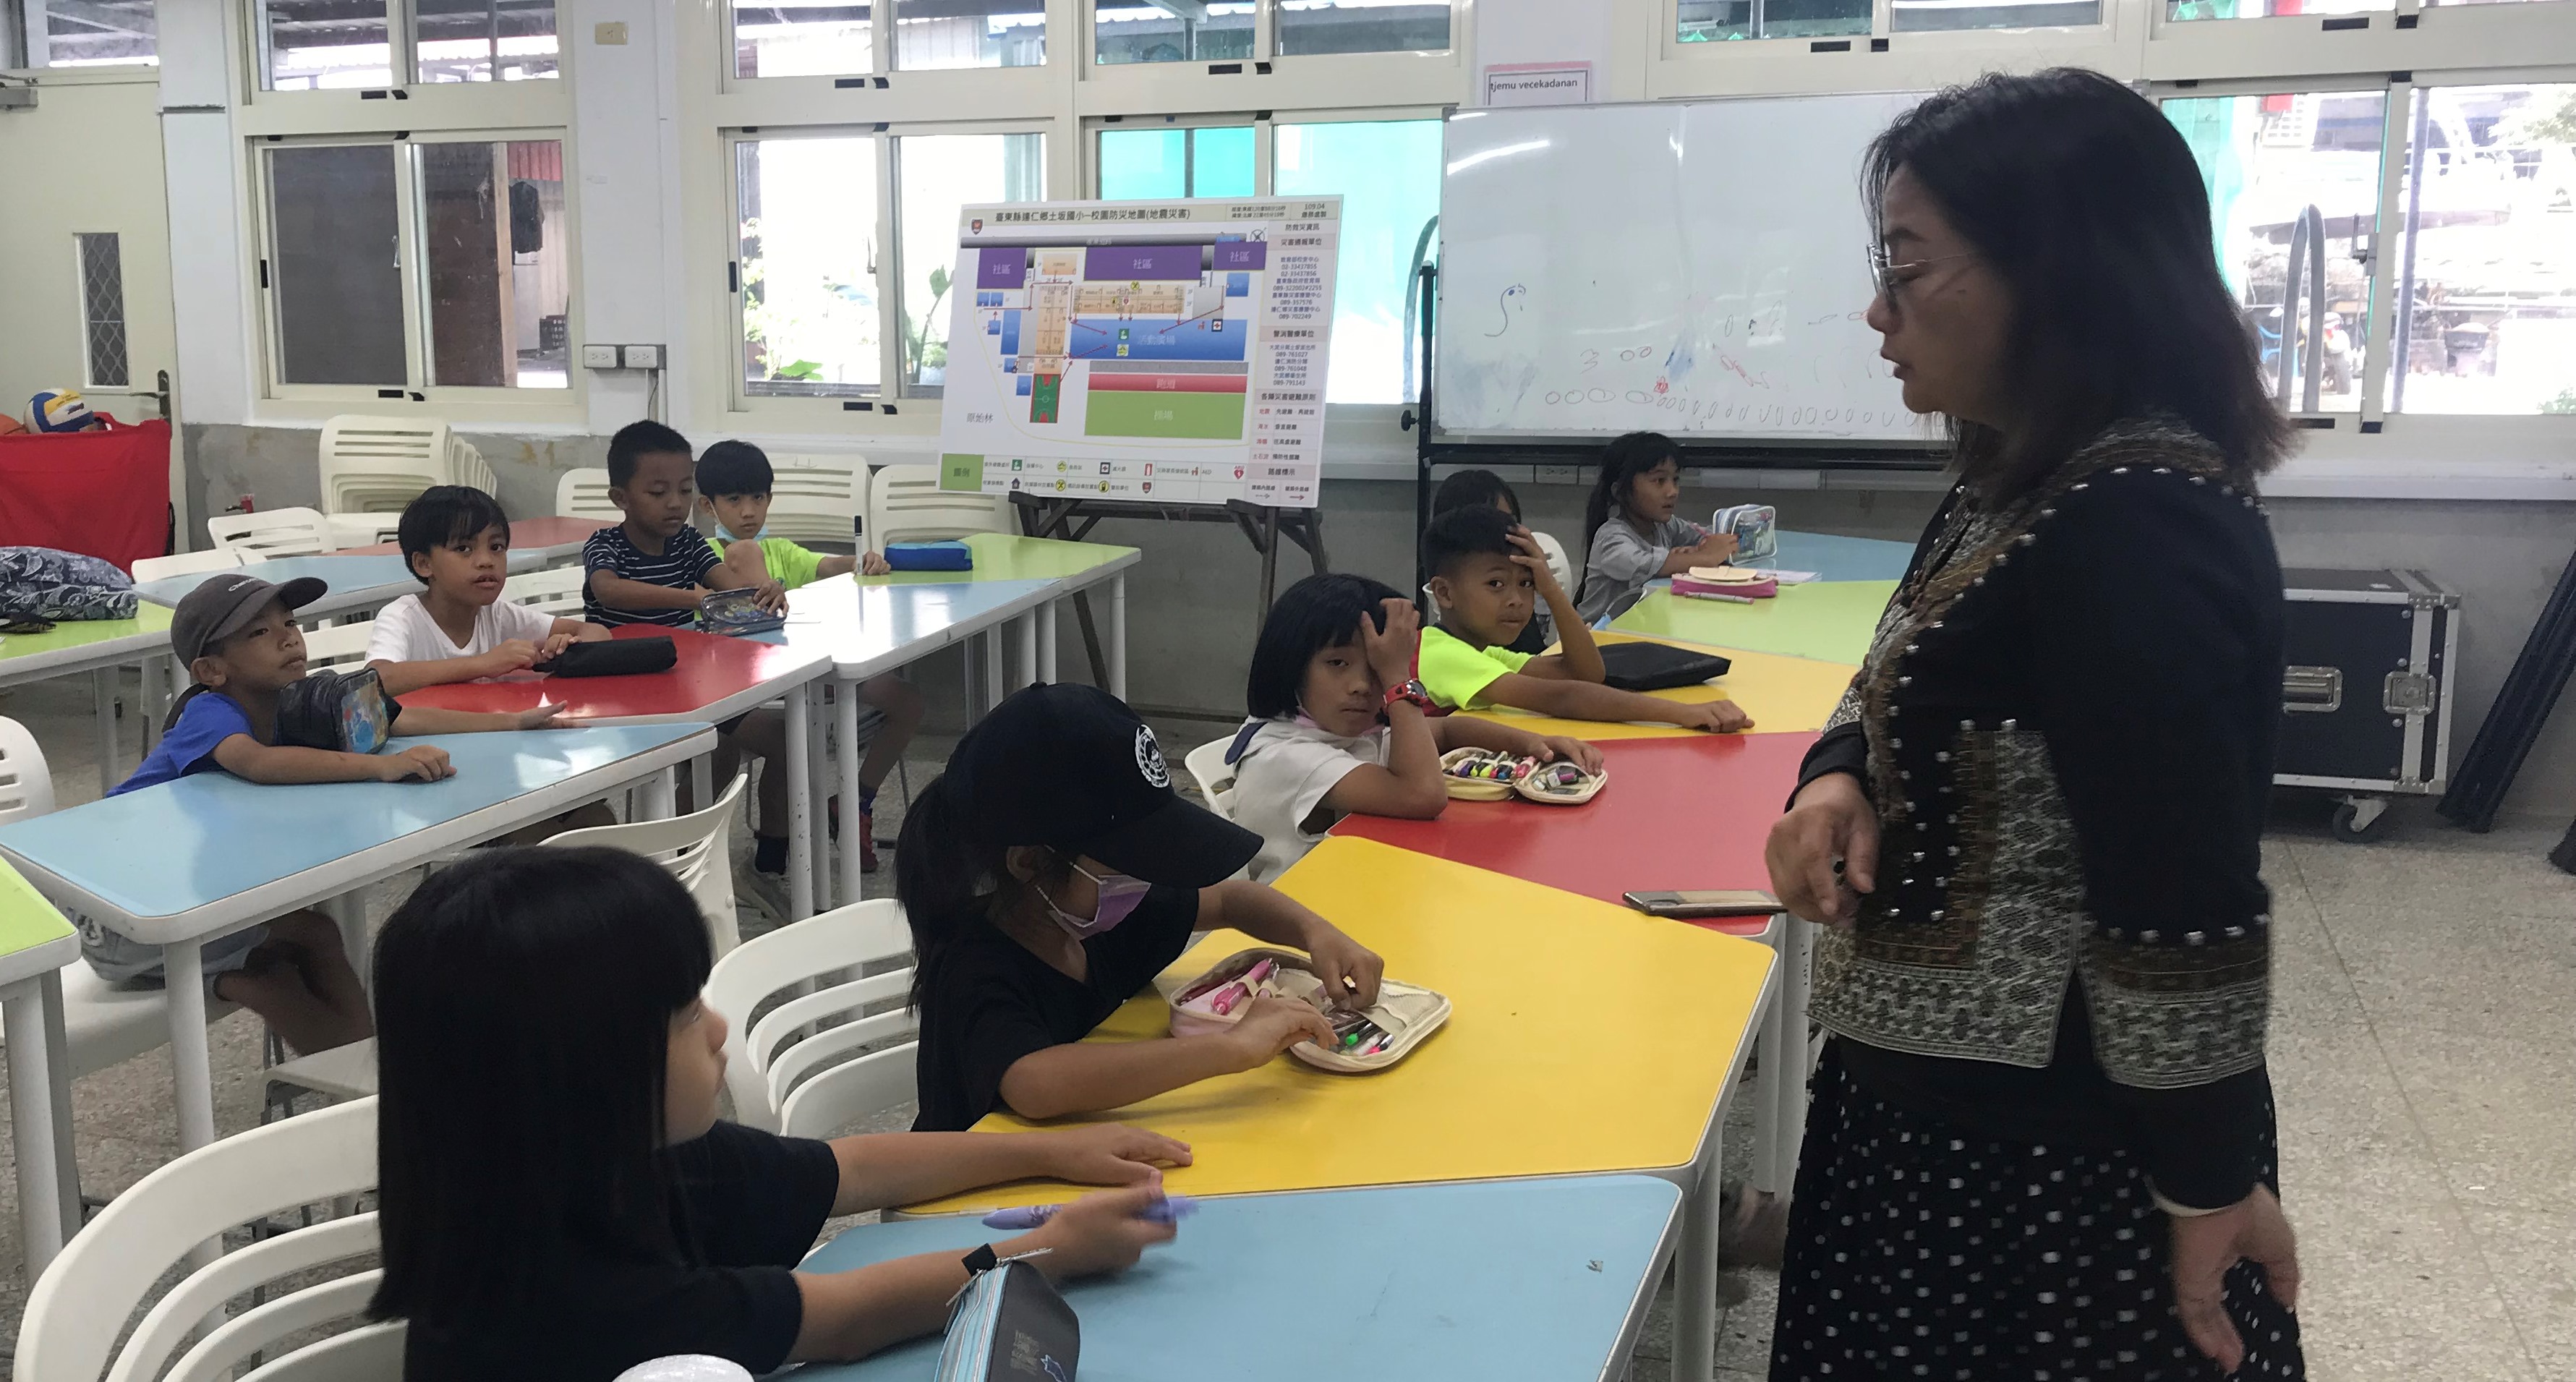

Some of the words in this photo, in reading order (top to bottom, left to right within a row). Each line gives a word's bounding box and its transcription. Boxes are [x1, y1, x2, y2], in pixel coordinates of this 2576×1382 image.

[1490, 81, 1517, 93] tjemu
[1519, 79, 1578, 90] vecekadanan
[1229, 250, 1250, 263] 社區
[993, 263, 1012, 275] 社區
[1133, 258, 1153, 270] 社區
